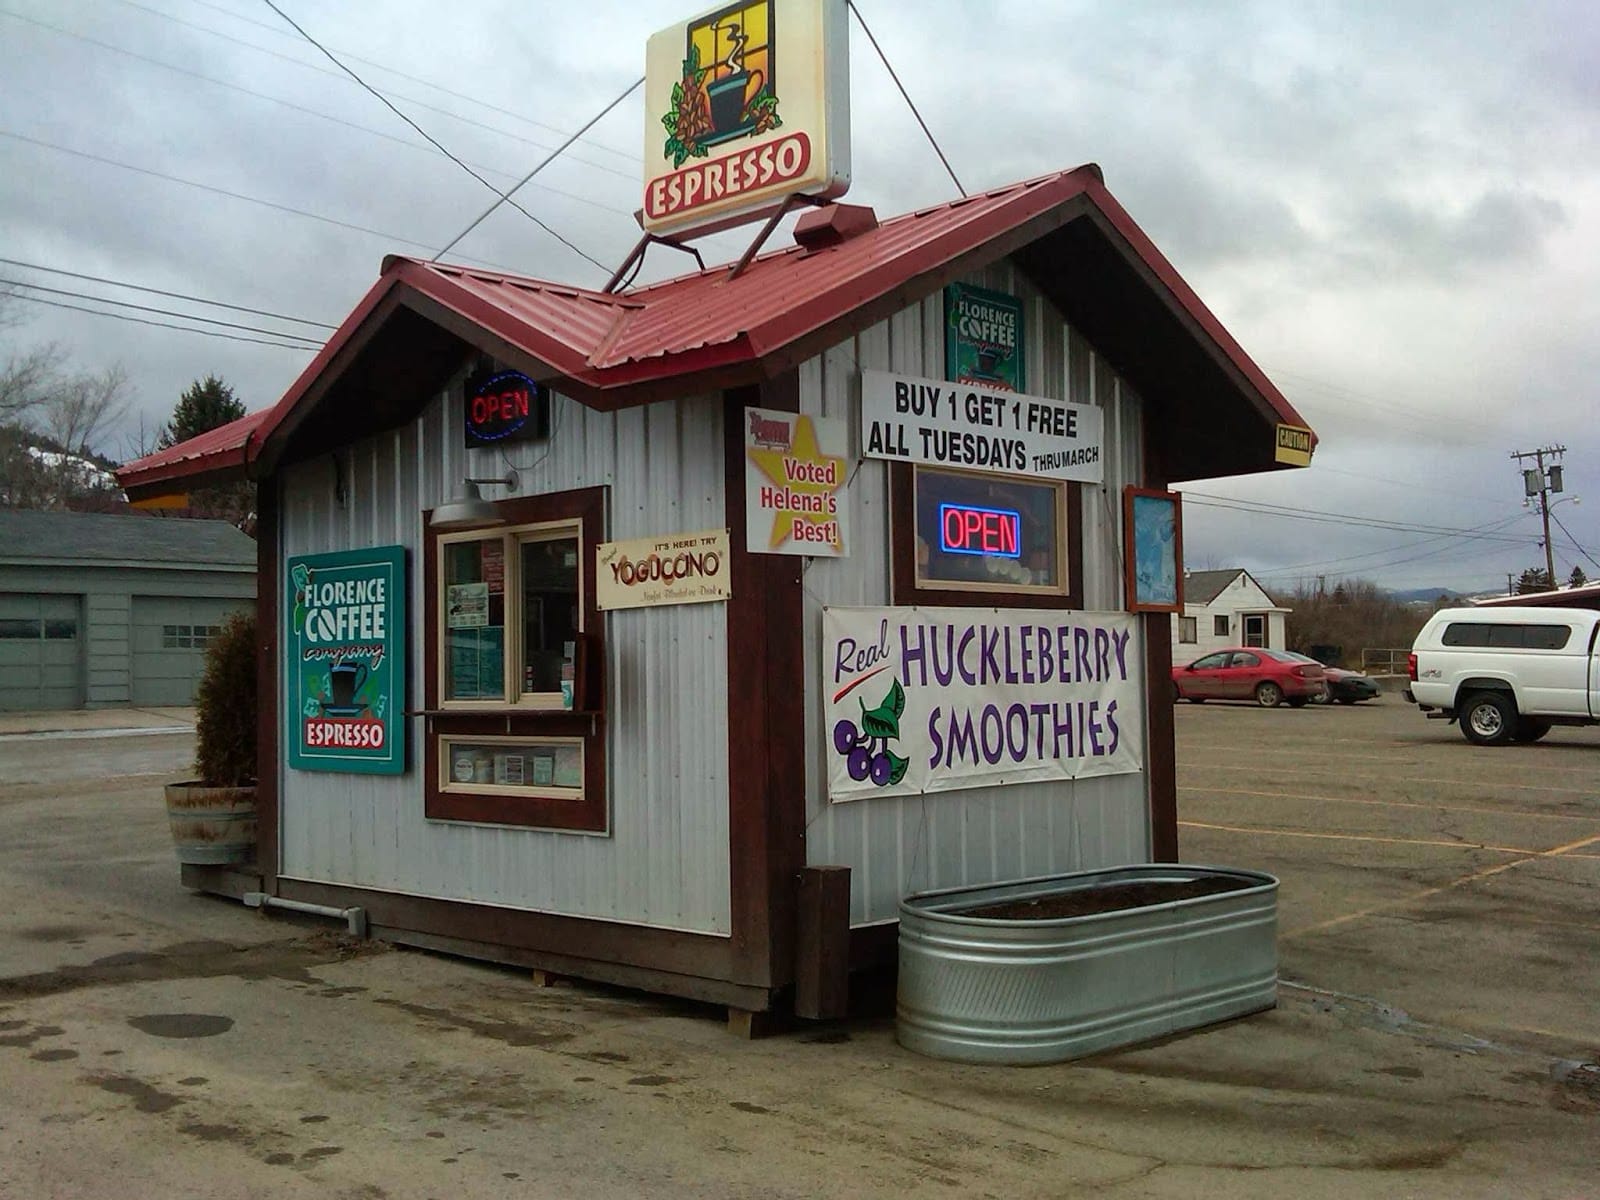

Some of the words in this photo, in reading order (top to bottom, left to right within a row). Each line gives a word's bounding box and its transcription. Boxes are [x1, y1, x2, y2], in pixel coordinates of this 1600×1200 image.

[652, 138, 802, 216] ESPRESSO
[959, 301, 1015, 327] FLORENCE
[959, 316, 1015, 347] COFFEE
[472, 390, 529, 424] OPEN
[895, 381, 941, 418] BUY
[948, 391, 957, 421] 1
[965, 392, 1006, 428] GET
[1012, 401, 1021, 430] 1
[1027, 403, 1078, 438] FREE
[868, 421, 909, 456] ALL
[919, 427, 1026, 470] TUESDAYS
[784, 458, 836, 484] Voted
[761, 486, 837, 513] Helena's
[655, 543, 669, 551] IT'S
[673, 539, 697, 550] HERE!
[701, 537, 717, 546] TRY
[793, 519, 837, 543] Best!
[944, 509, 1017, 553] OPEN
[611, 551, 720, 585] YOGUCCINO
[304, 578, 385, 608] FLORENCE
[305, 604, 385, 642] COFFEE
[303, 644, 386, 671] company
[835, 618, 891, 684] Real
[900, 625, 1130, 688] HUCKLEBERRY
[307, 723, 384, 747] ESPRESSO
[929, 700, 1120, 770] SMOOTHIES
